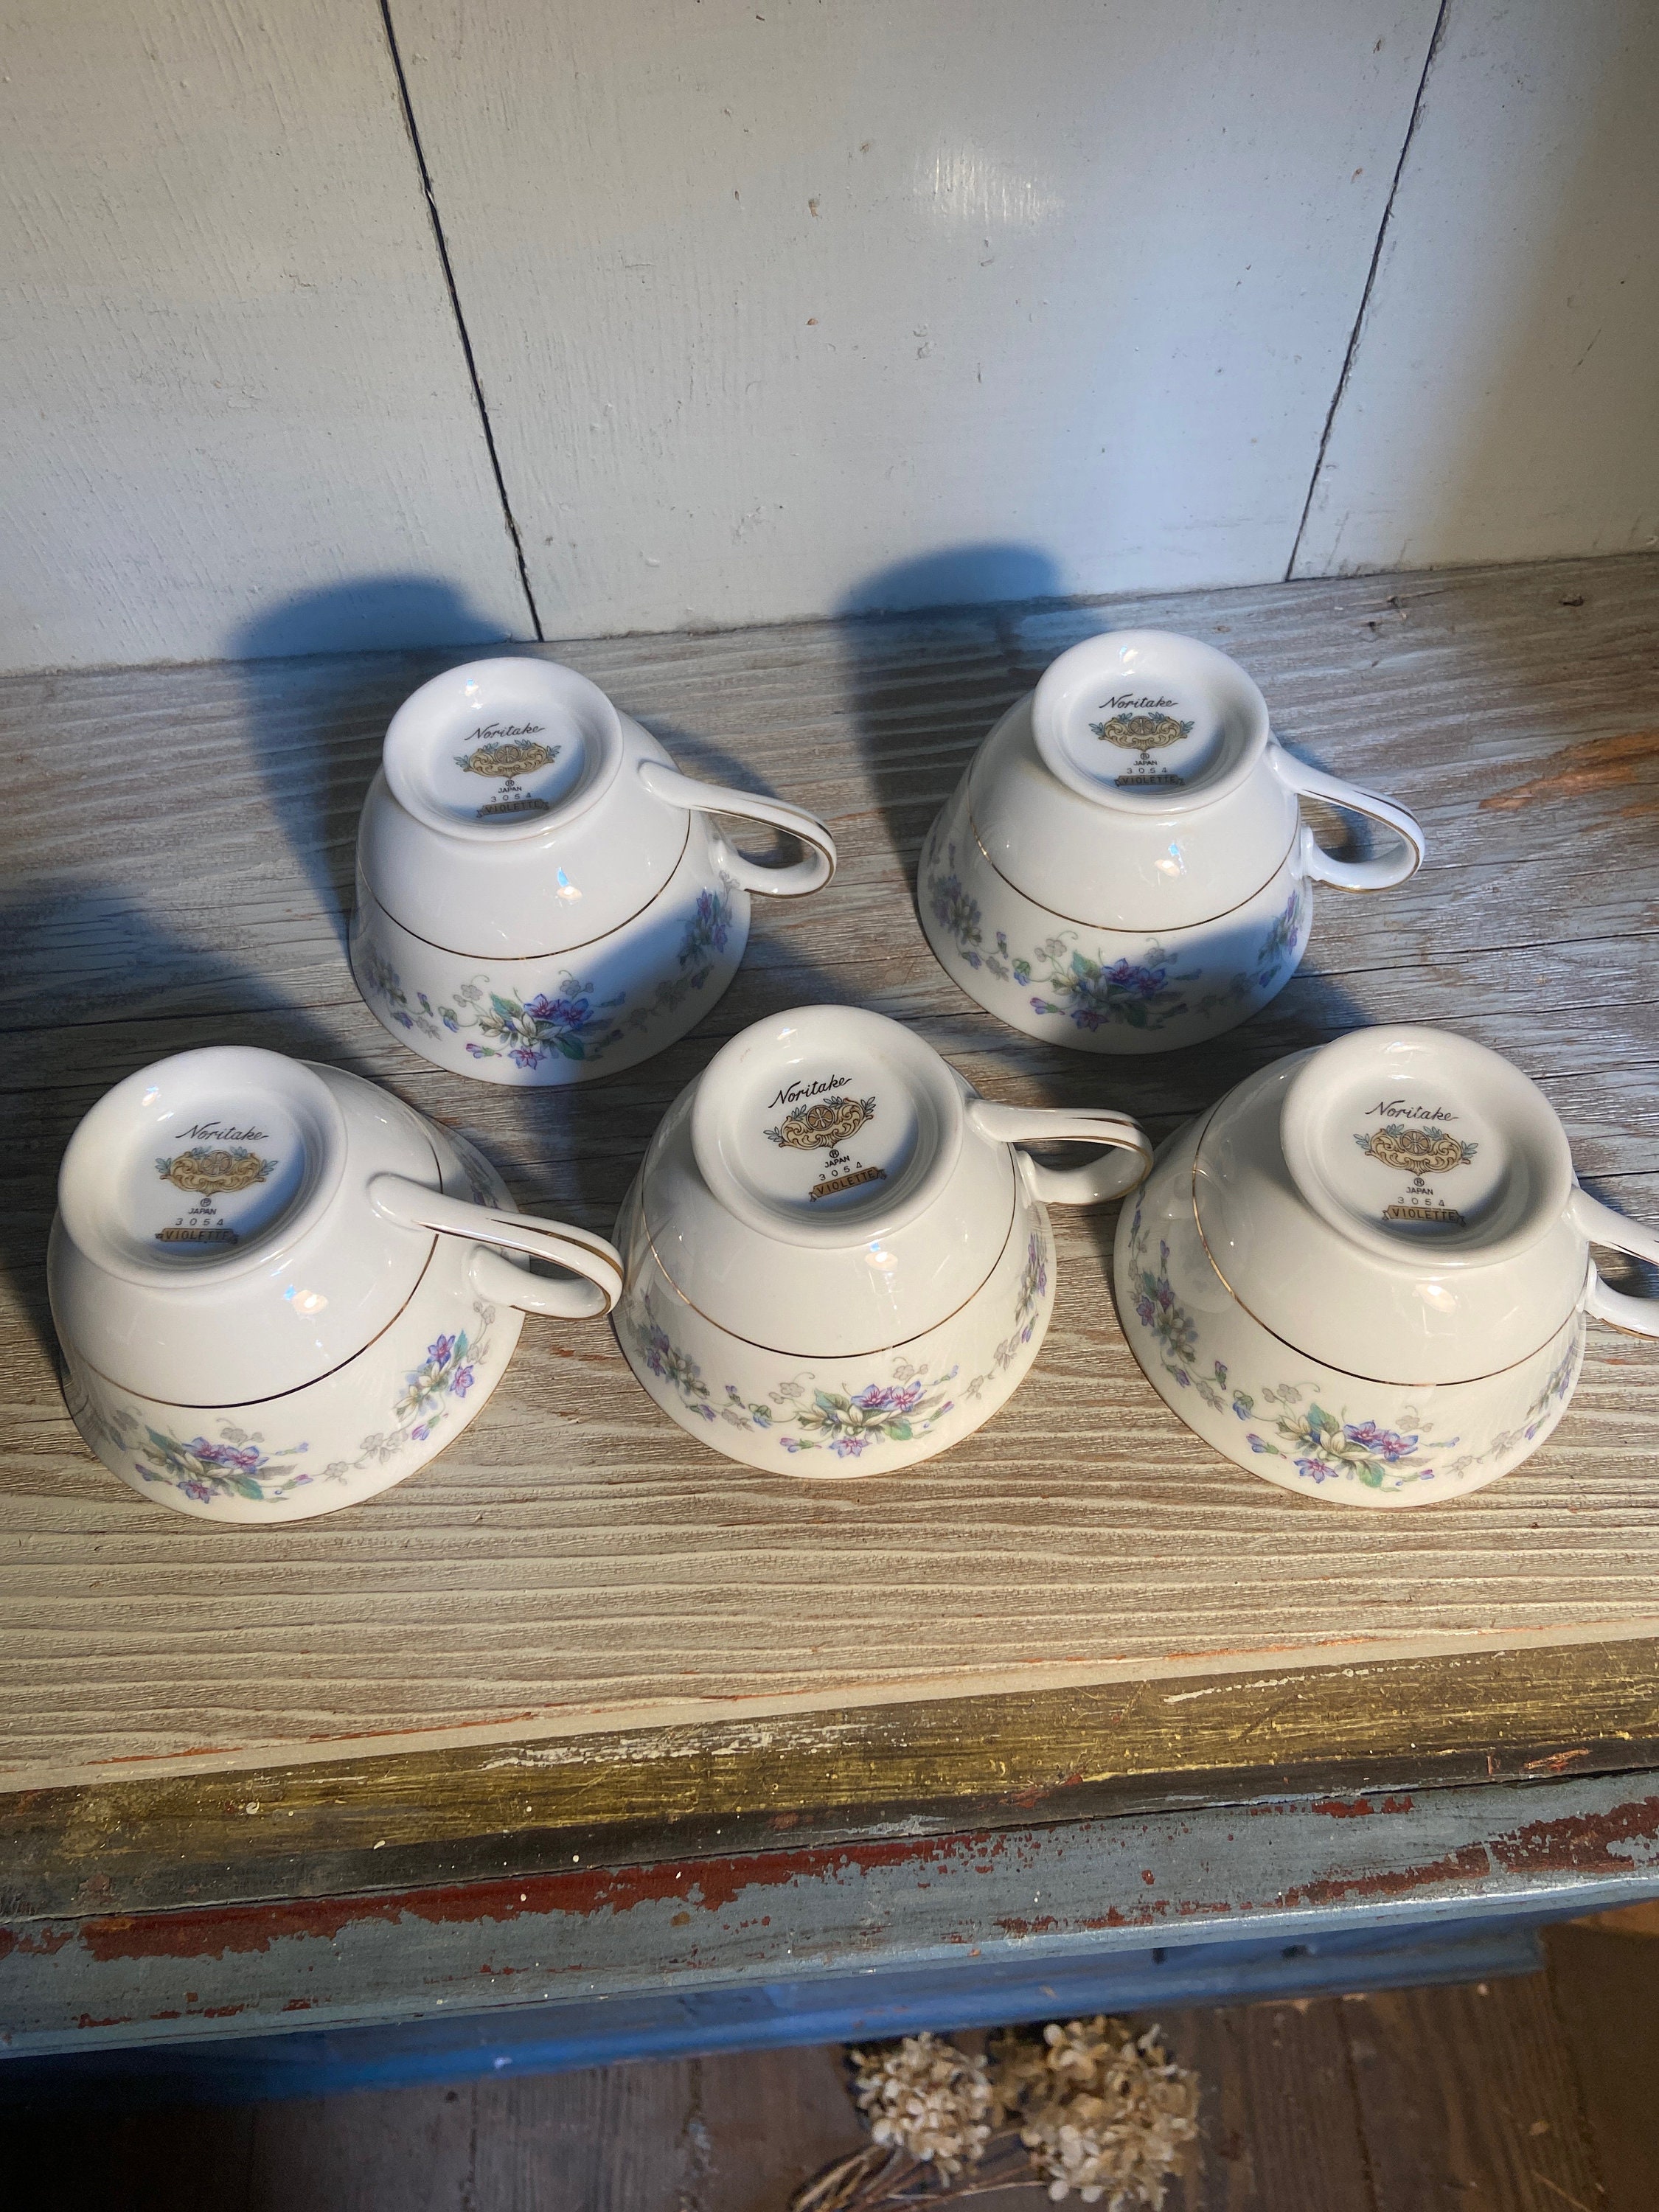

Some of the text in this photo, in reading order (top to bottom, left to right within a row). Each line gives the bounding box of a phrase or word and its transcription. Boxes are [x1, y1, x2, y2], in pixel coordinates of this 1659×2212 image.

[1099, 693, 1178, 709] Noritake
[464, 723, 546, 740] Noritake
[485, 800, 542, 812] VIOLETTE
[768, 1074, 852, 1108] Noritake
[1365, 1099, 1460, 1121] Noritake
[175, 1121, 269, 1140] Noritake
[824, 1155, 850, 1168] JAPAN
[818, 1169, 874, 1194] VIOLETTE
[1406, 1186, 1433, 1195] JAPAN
[1392, 1208, 1458, 1222] VIOLETTE
[165, 1231, 230, 1240] VIOLETTE
